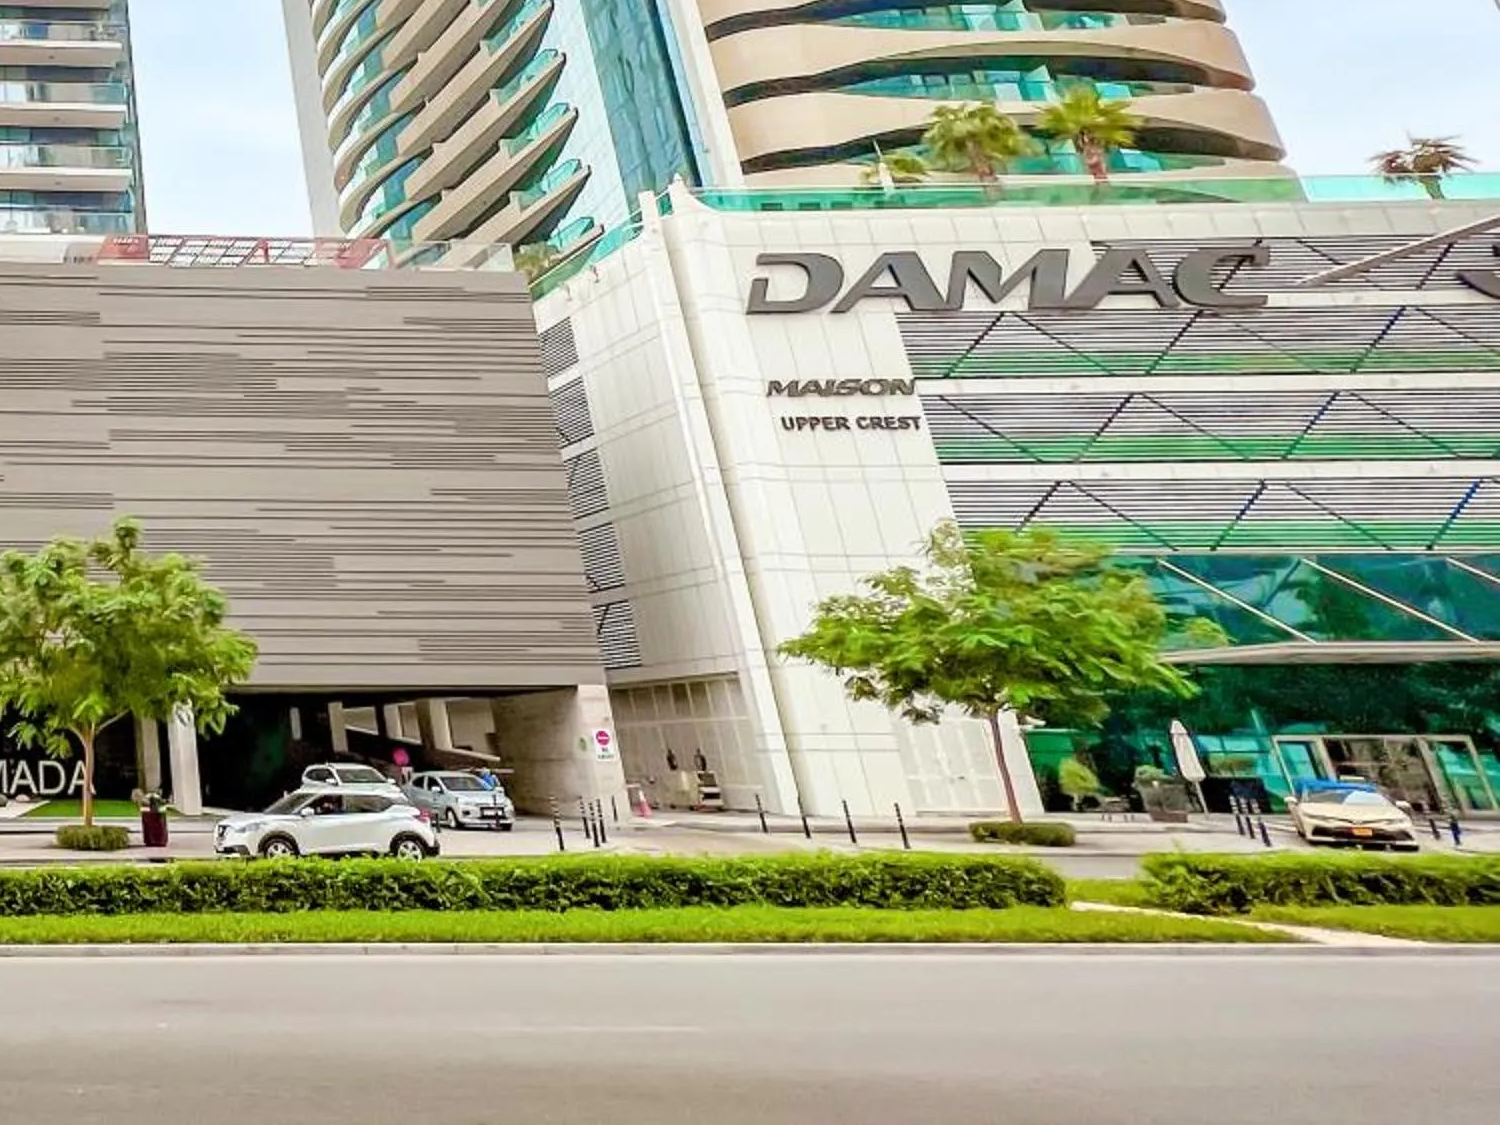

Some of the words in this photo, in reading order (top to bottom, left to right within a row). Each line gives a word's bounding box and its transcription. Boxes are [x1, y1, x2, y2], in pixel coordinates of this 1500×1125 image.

[745, 245, 1270, 315] DAMAC
[766, 378, 916, 398] MAISON
[781, 416, 850, 431] UPPER
[855, 416, 921, 431] CREST
